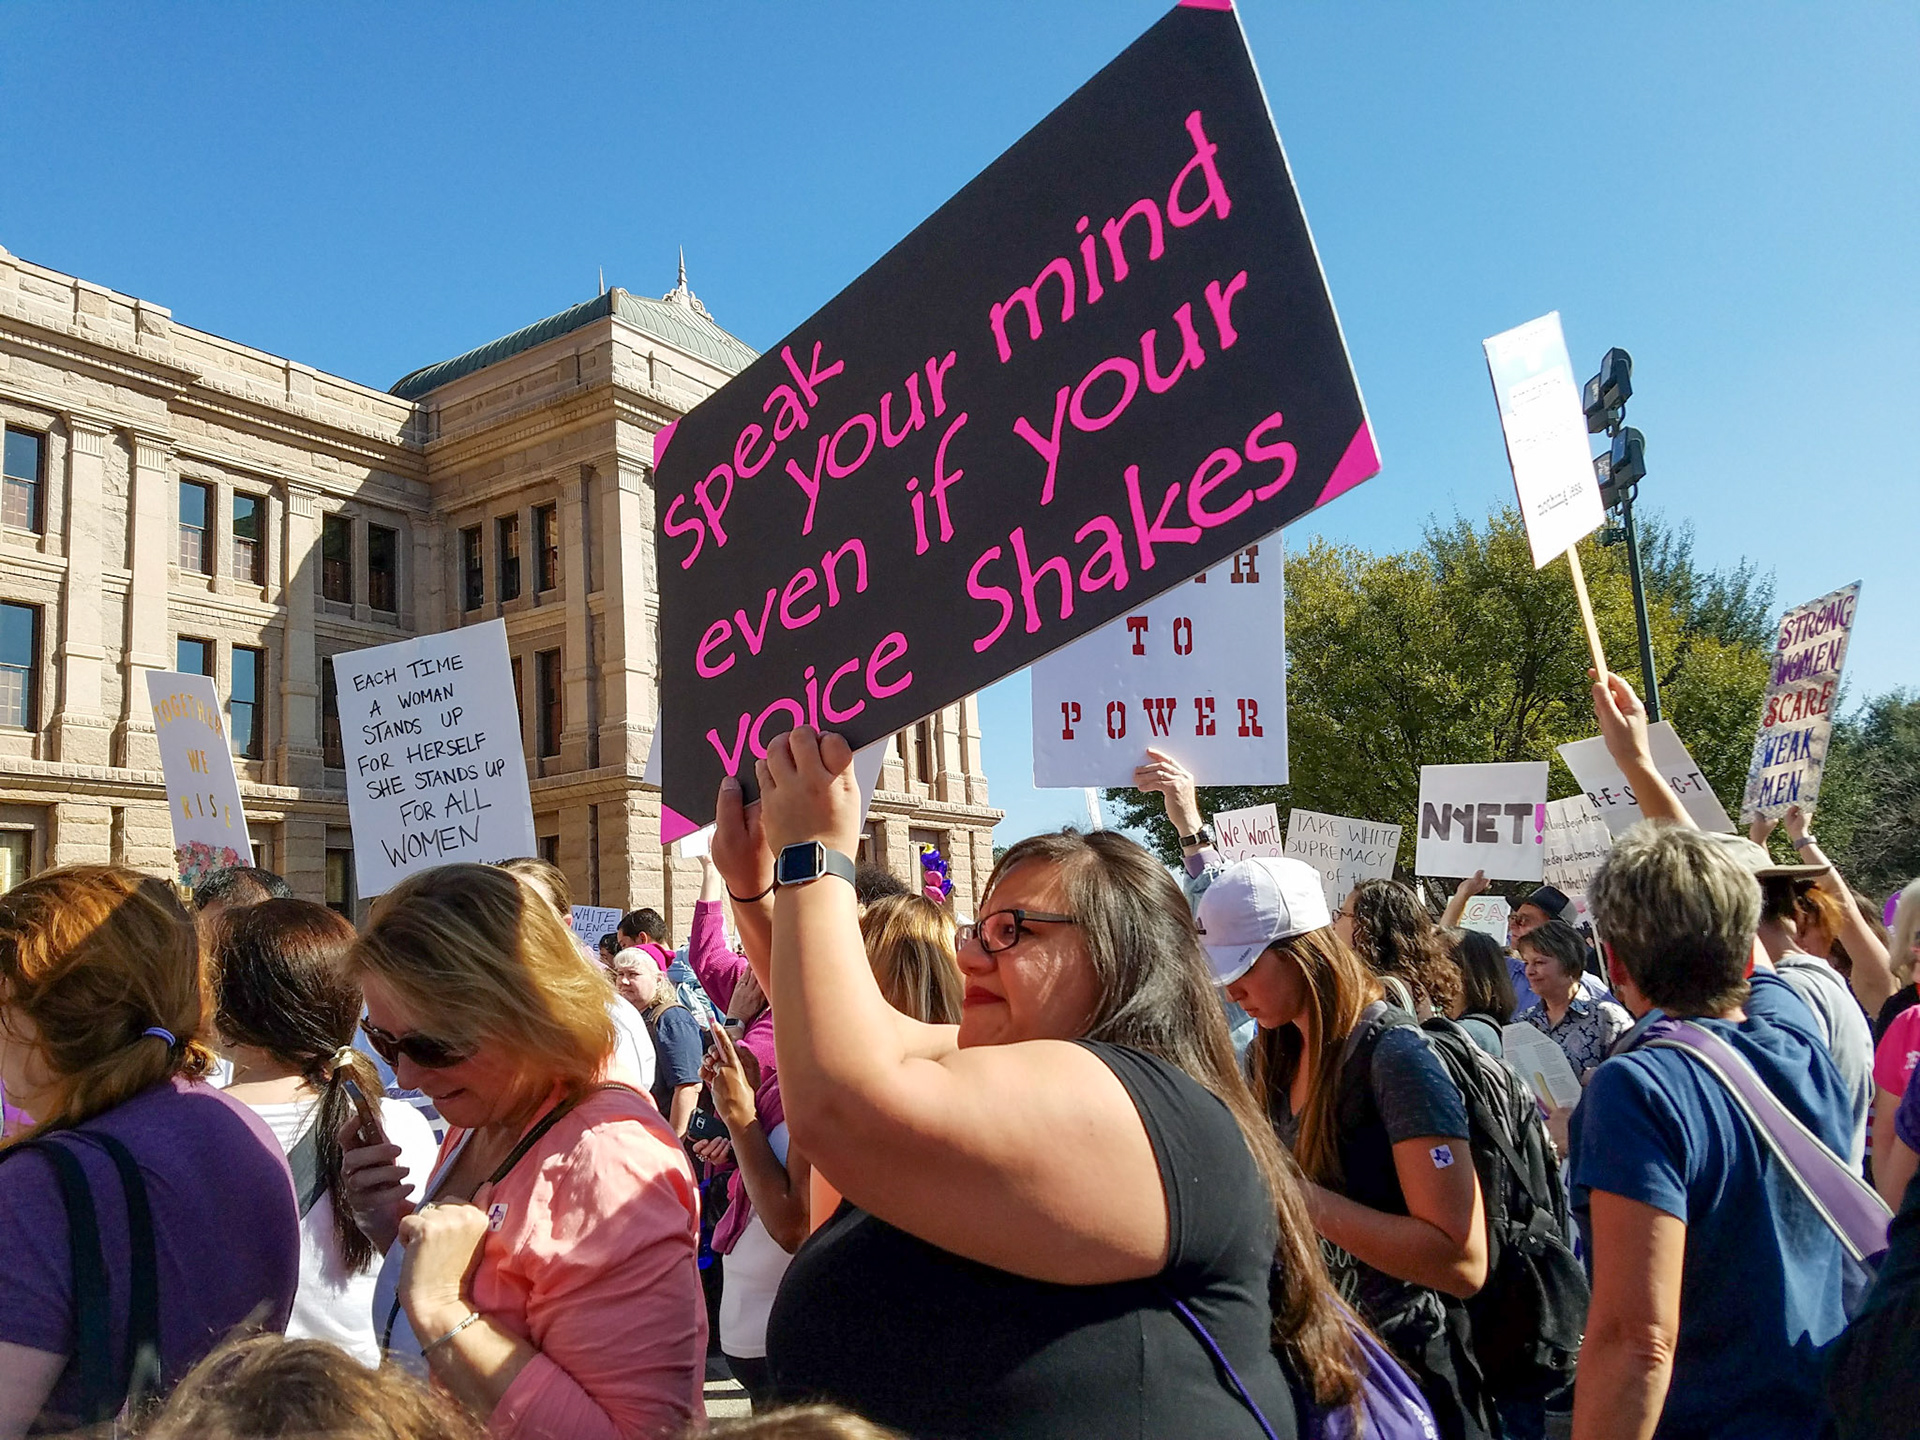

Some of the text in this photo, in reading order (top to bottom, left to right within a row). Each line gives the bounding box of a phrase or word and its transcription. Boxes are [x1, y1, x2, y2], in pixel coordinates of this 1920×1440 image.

[785, 350, 956, 536] your
[989, 110, 1231, 363] mind
[695, 270, 1247, 679] even if your
[1126, 616, 1193, 656] TO
[1778, 595, 1854, 650] STRONG
[352, 654, 464, 692] EACH TIME
[1776, 637, 1843, 686] WOMEN
[153, 692, 223, 740] TOGETHER
[369, 682, 454, 718] A WOMAN
[706, 631, 913, 777] voice
[1061, 697, 1264, 741] POWER
[1762, 680, 1835, 729] SCARE
[362, 706, 463, 746] STANDS UP
[186, 749, 209, 775] WE
[357, 732, 486, 777] FOR HERSELF
[1761, 727, 1815, 769] WEAK
[366, 758, 505, 800] SHE STANDS UP
[1757, 769, 1803, 809] MEN
[180, 792, 232, 829] RISE
[399, 787, 492, 827] FOR ALL
[1420, 802, 1546, 845] NYET!
[380, 814, 480, 869] WOMEN
[1216, 815, 1280, 848] We Won't
[1293, 812, 1399, 849] TAKE WHITE
[1287, 836, 1387, 867] SUPREMACY
[571, 907, 616, 923] WHITE
[571, 922, 616, 932] ILENCE
[1461, 903, 1506, 921] CA
[583, 932, 595, 942] IS
